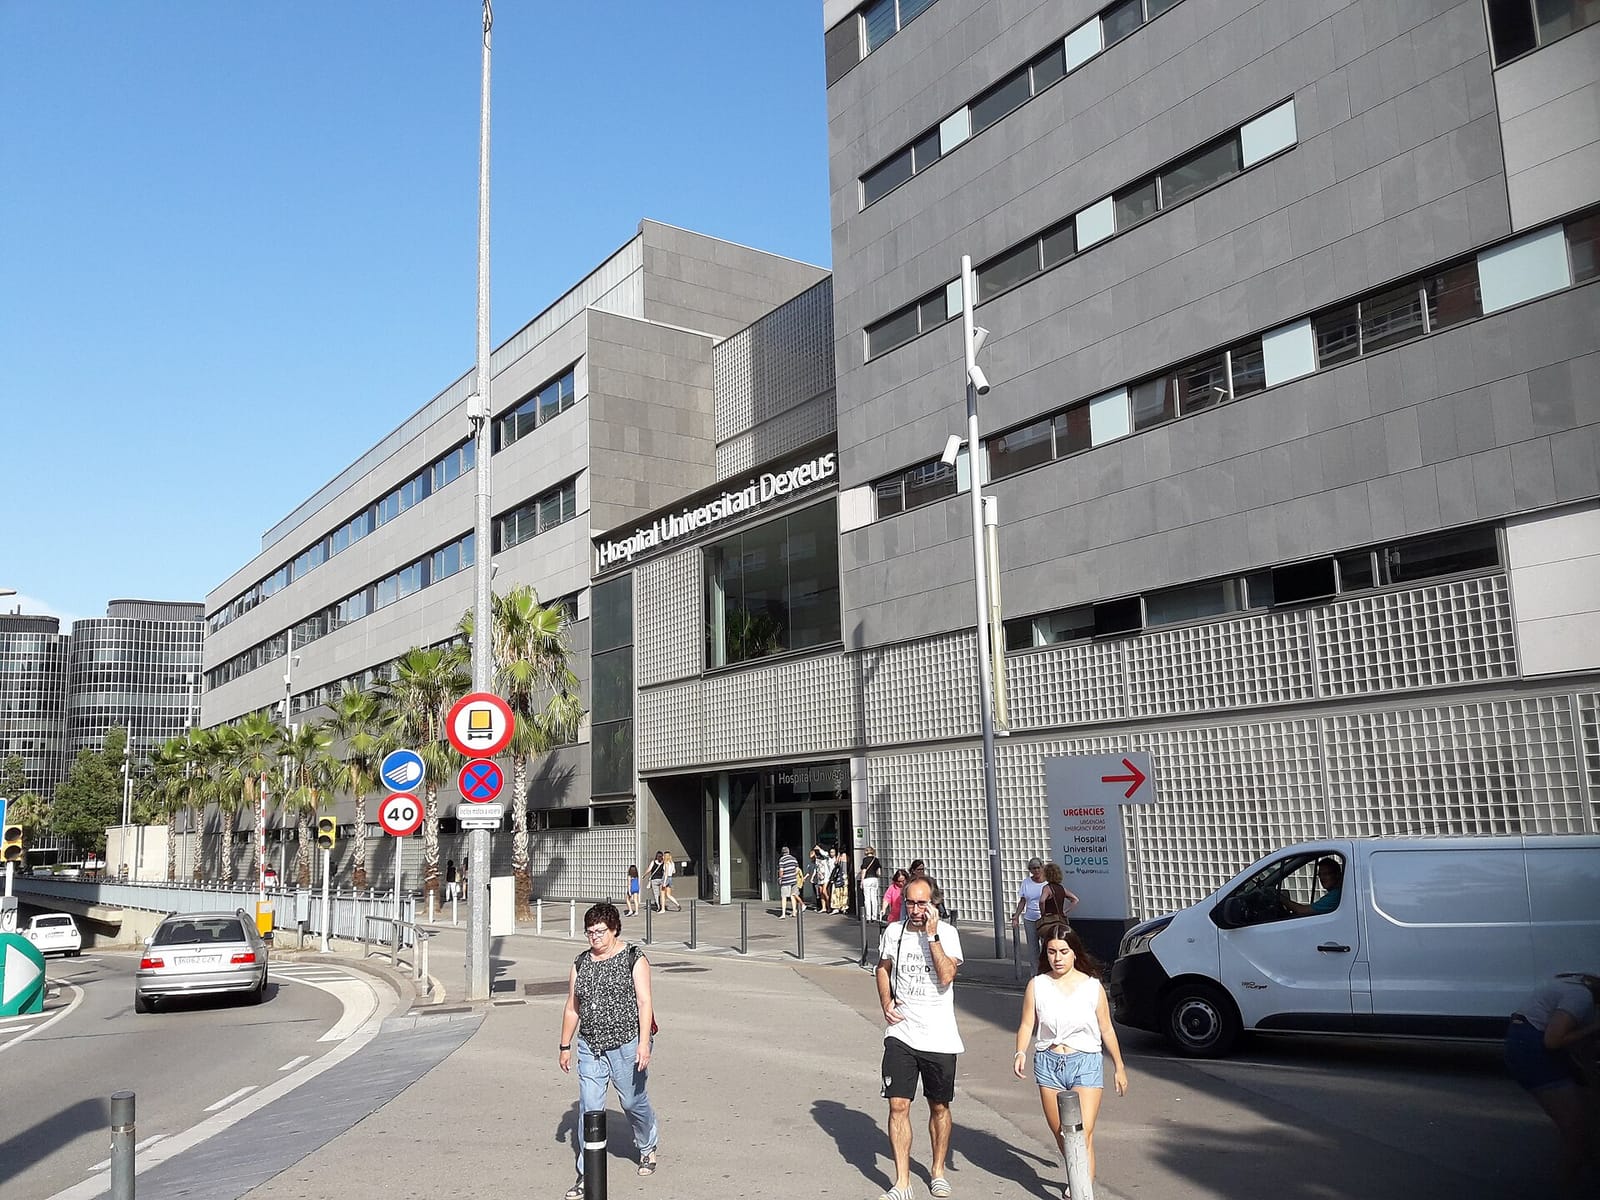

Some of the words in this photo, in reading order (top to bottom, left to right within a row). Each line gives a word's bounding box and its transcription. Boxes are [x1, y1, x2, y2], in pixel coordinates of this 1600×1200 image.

[600, 521, 660, 566] Hospital
[660, 480, 760, 541] Universitari
[760, 452, 837, 503] Dexeus
[778, 770, 812, 785] Hospital
[387, 807, 414, 821] 40
[1074, 835, 1107, 843] Hospital
[1063, 845, 1108, 853] Universitari
[1064, 854, 1109, 866] Dexeus
